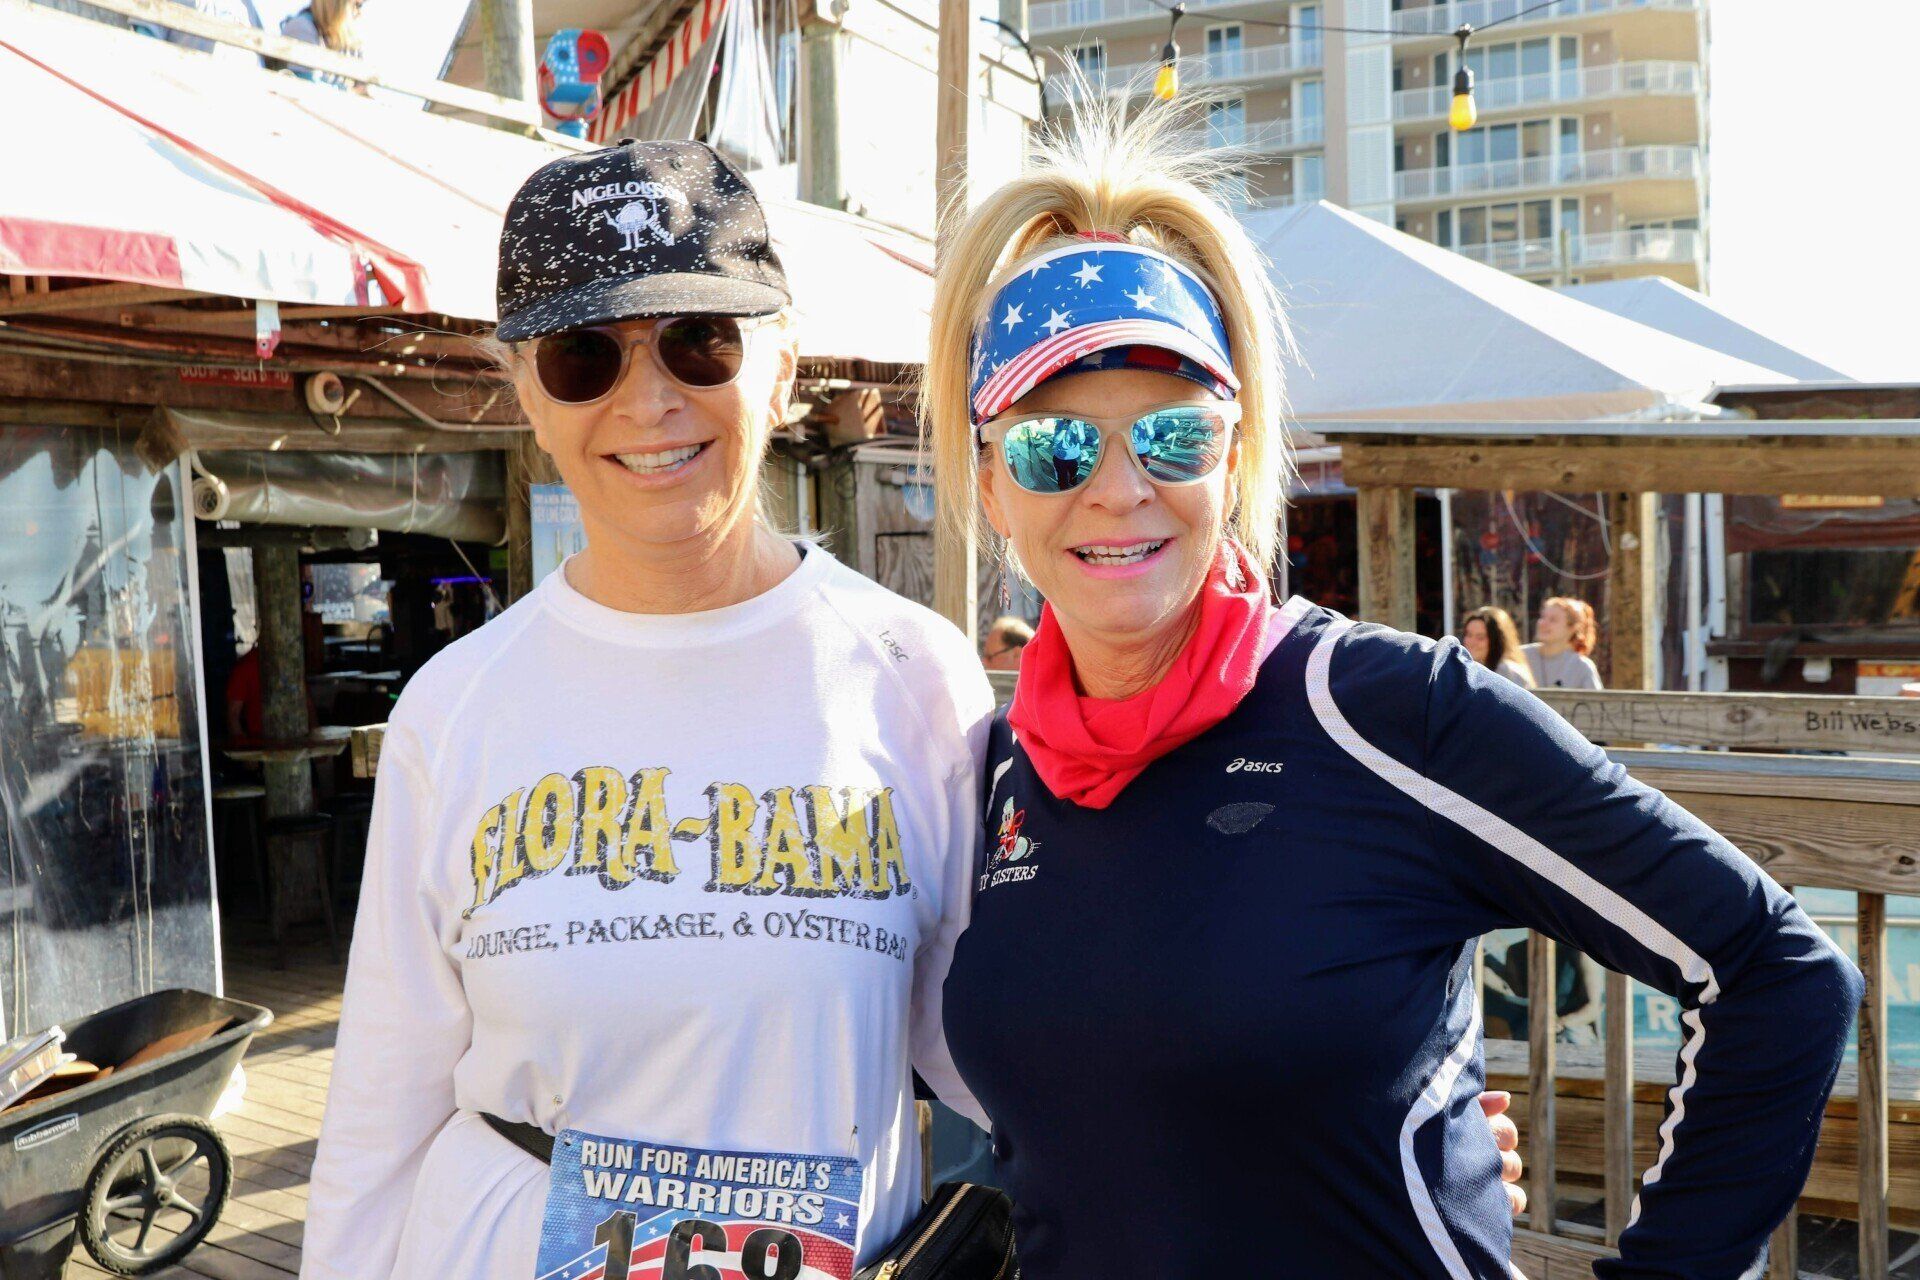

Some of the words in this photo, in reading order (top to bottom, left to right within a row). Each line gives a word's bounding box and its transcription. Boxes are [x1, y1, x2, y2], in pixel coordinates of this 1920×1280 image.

[1806, 710, 1844, 731] Bill
[1849, 712, 1920, 734] Webs
[990, 865, 1039, 888] SISTERS
[467, 923, 560, 959] LOUNGE,
[566, 911, 725, 945] PACKAGE,
[732, 911, 757, 937] &
[763, 908, 871, 950] OYSTER
[581, 1140, 634, 1169] RUN
[641, 1149, 688, 1176] FOR
[695, 1157, 831, 1191] AMERICA'S
[582, 1170, 826, 1225] WARRIORS
